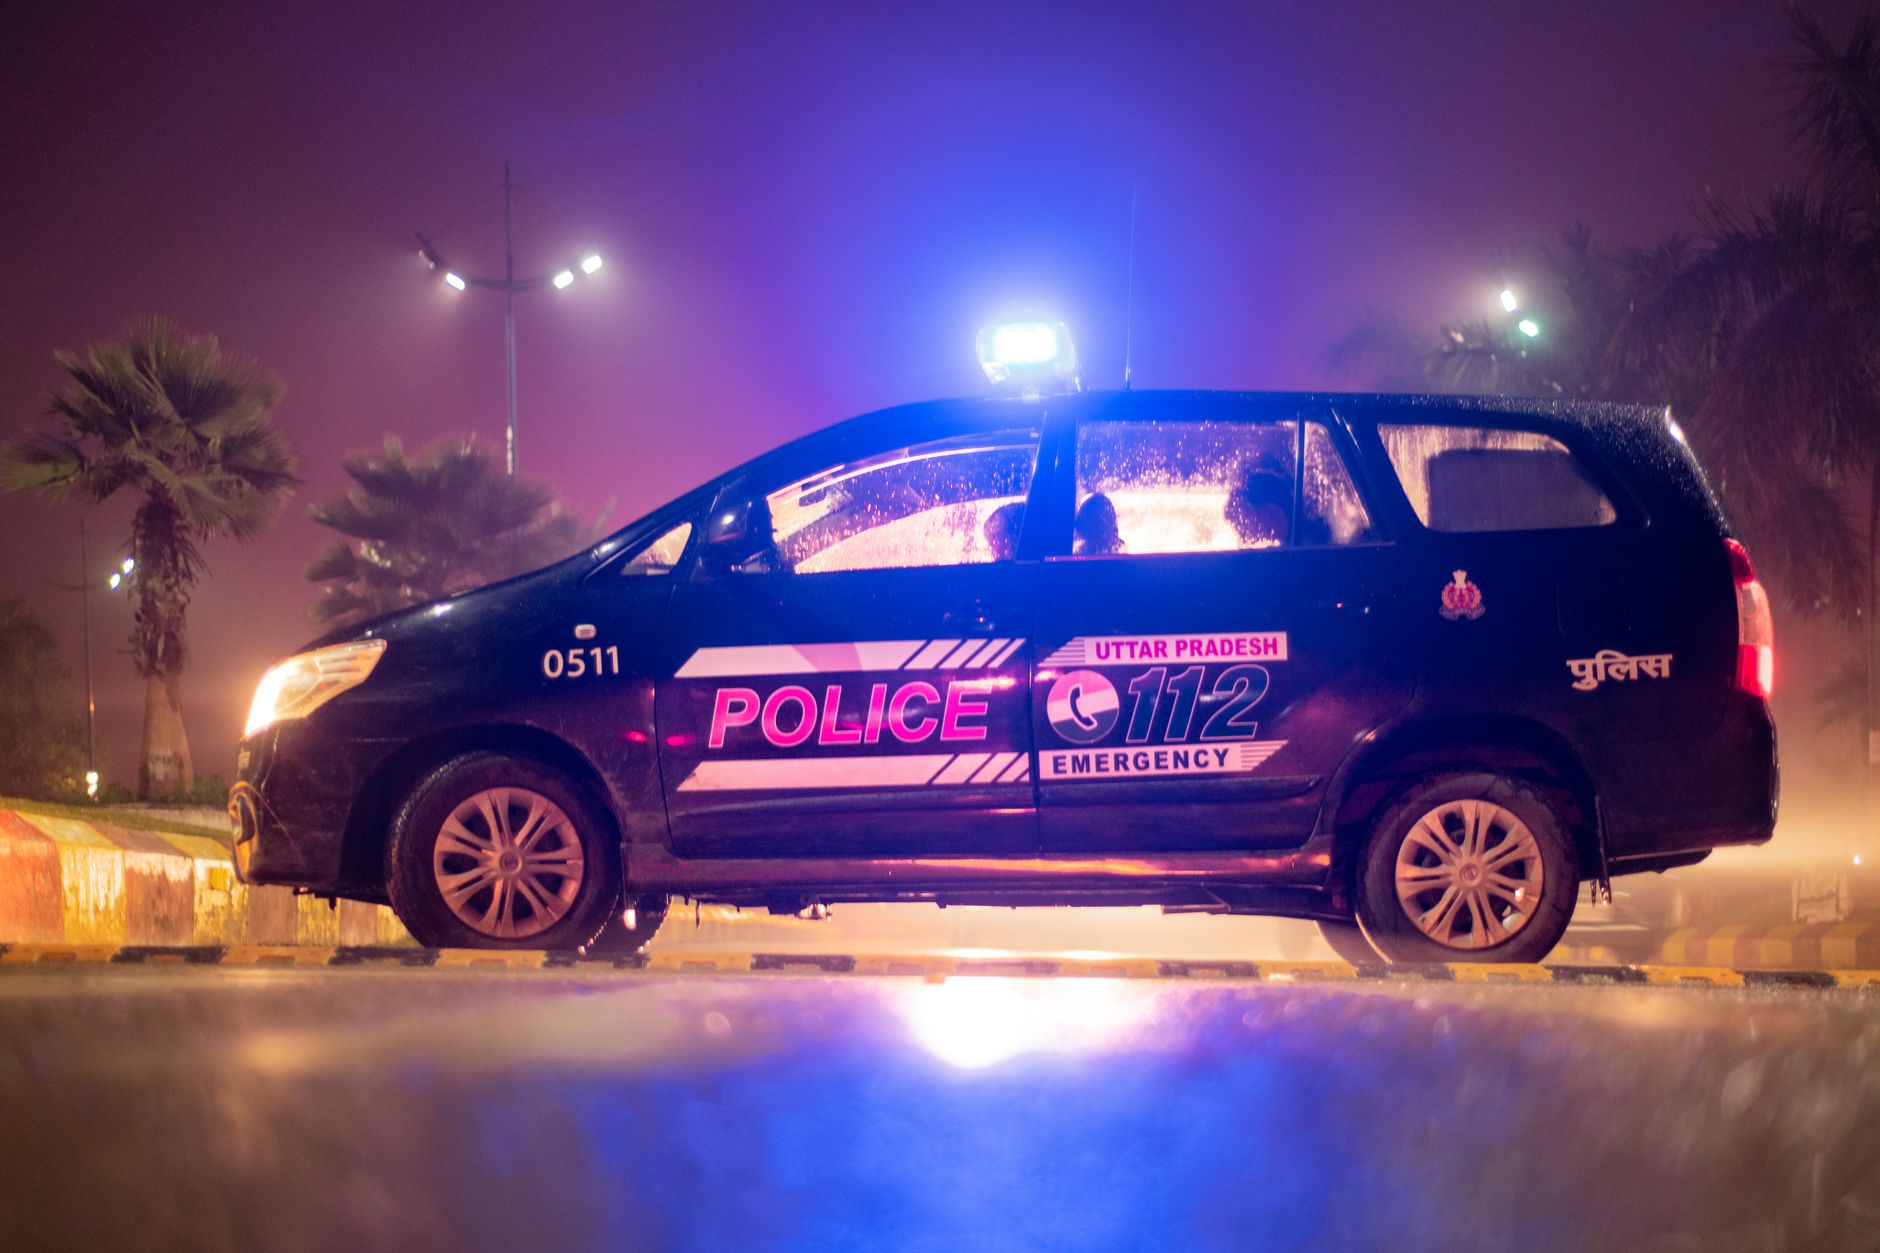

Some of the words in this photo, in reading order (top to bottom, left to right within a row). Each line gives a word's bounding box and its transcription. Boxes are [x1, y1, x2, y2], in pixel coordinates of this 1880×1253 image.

[543, 645, 620, 679] 0511
[1095, 641, 1168, 660] UTTAR
[1175, 637, 1278, 658] PRADESH
[1566, 649, 1673, 691] पुलिस
[708, 681, 992, 748] POLICE
[1126, 664, 1270, 743] 112
[1052, 748, 1230, 775] EMERGENCY
